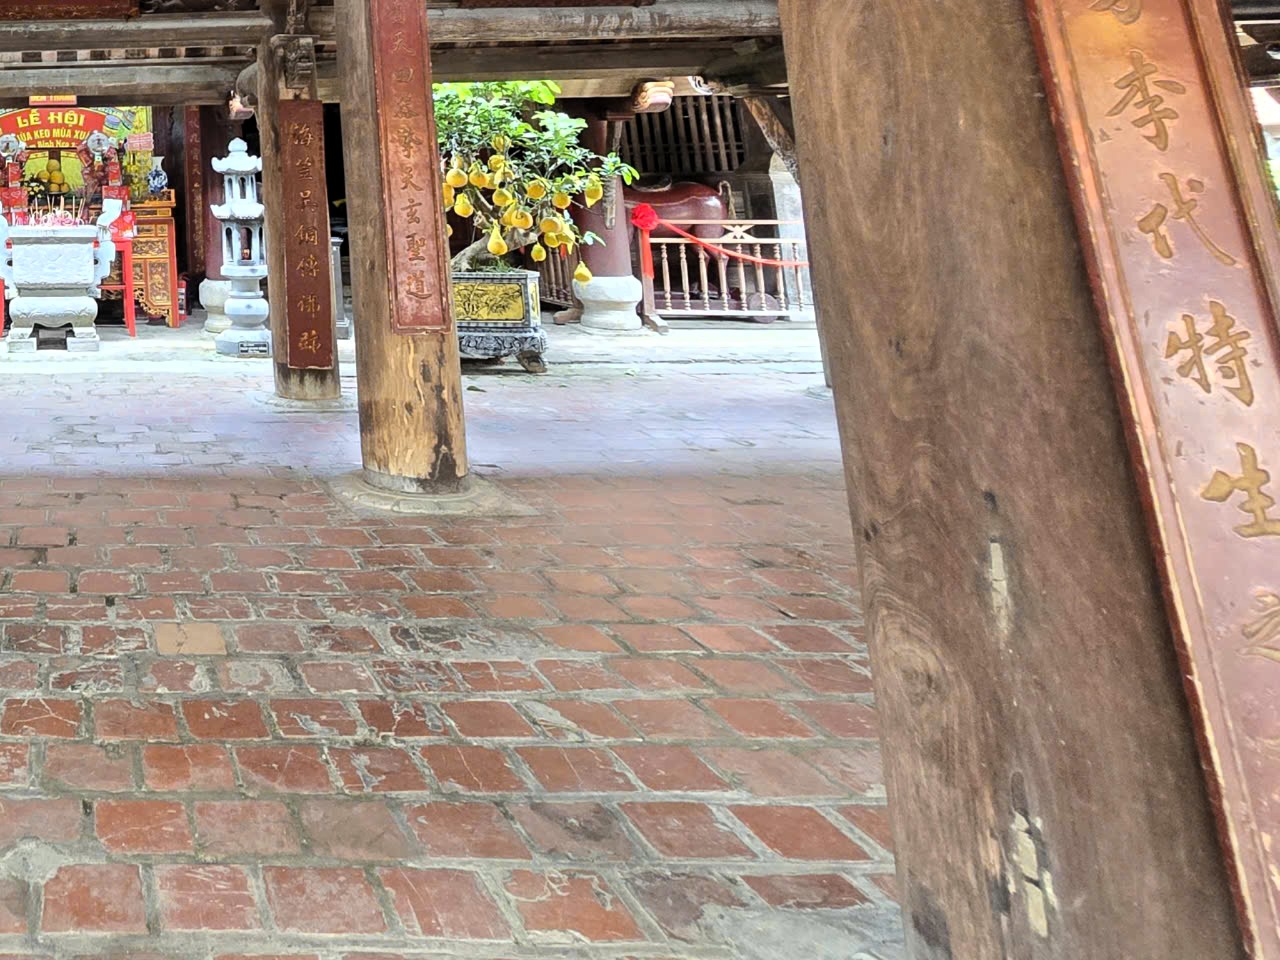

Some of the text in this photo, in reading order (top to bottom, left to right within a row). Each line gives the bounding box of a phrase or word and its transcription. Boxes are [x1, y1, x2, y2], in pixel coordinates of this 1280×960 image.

[16, 109, 86, 129] LỄ HỘI
[17, 130, 33, 142] ÙA
